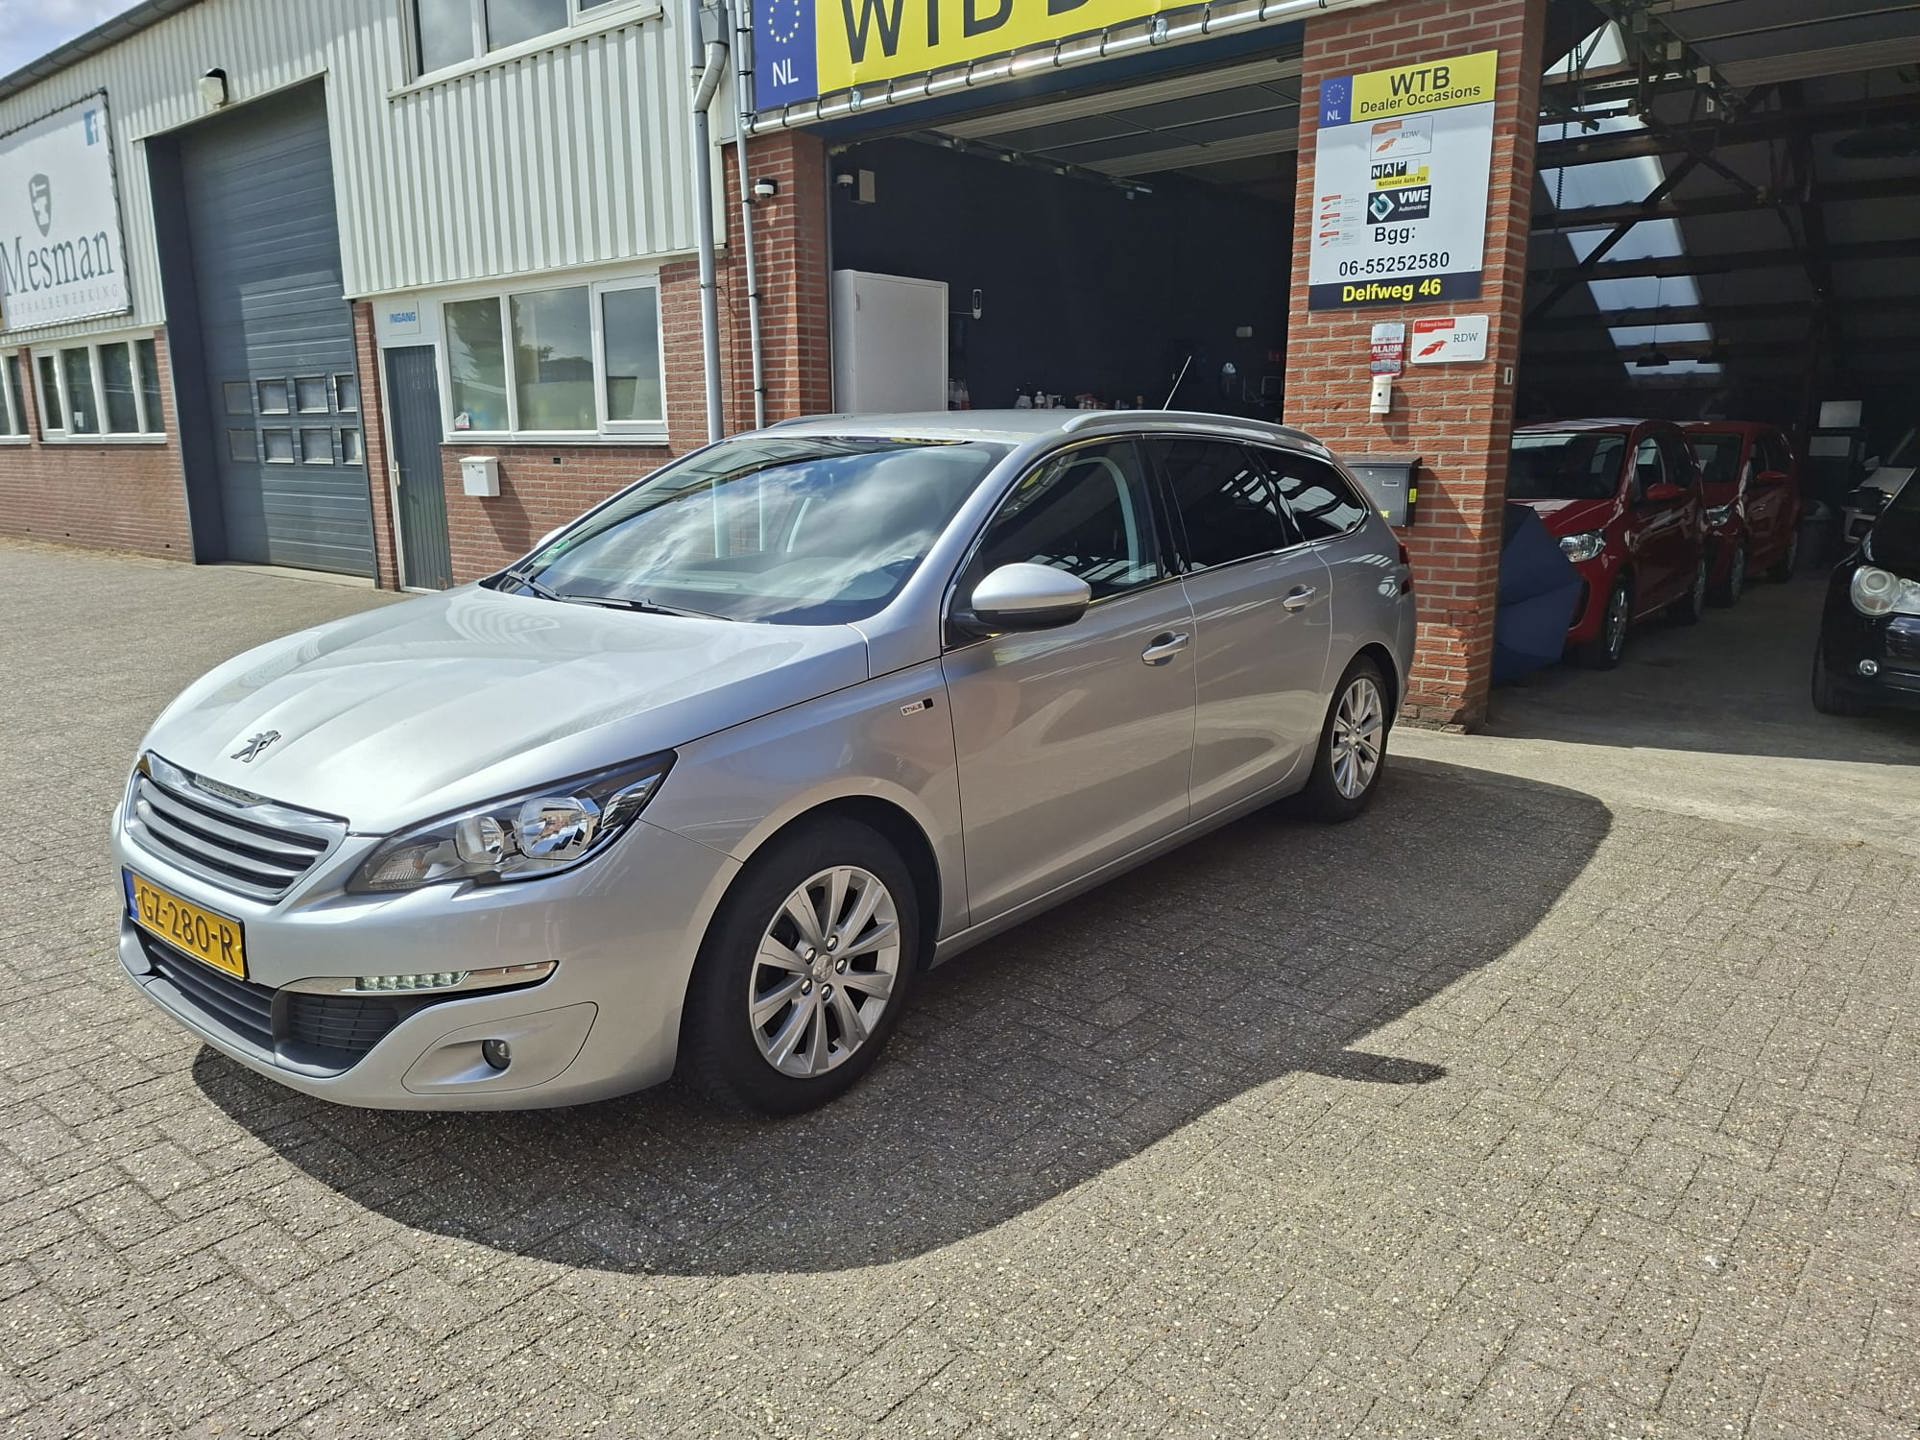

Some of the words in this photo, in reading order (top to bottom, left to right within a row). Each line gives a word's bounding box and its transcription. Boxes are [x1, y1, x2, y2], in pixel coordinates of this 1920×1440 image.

[772, 58, 799, 87] NL
[1390, 66, 1450, 97] WTB
[1360, 98, 1403, 114] Dealer
[1407, 85, 1481, 107] Occasions
[1326, 110, 1341, 121] NL
[1399, 189, 1430, 204] VWE
[1374, 226, 1417, 244] Bgg:
[0, 230, 115, 297] Mesman
[1339, 251, 1450, 276] 06-55252580
[9, 283, 120, 316] ETAALBEWERKING
[1342, 283, 1414, 302] Delfweg
[1419, 278, 1442, 296] 46
[1371, 344, 1402, 354] ALARM
[1453, 332, 1479, 343] RDW
[140, 886, 236, 966] GZ-280-R
